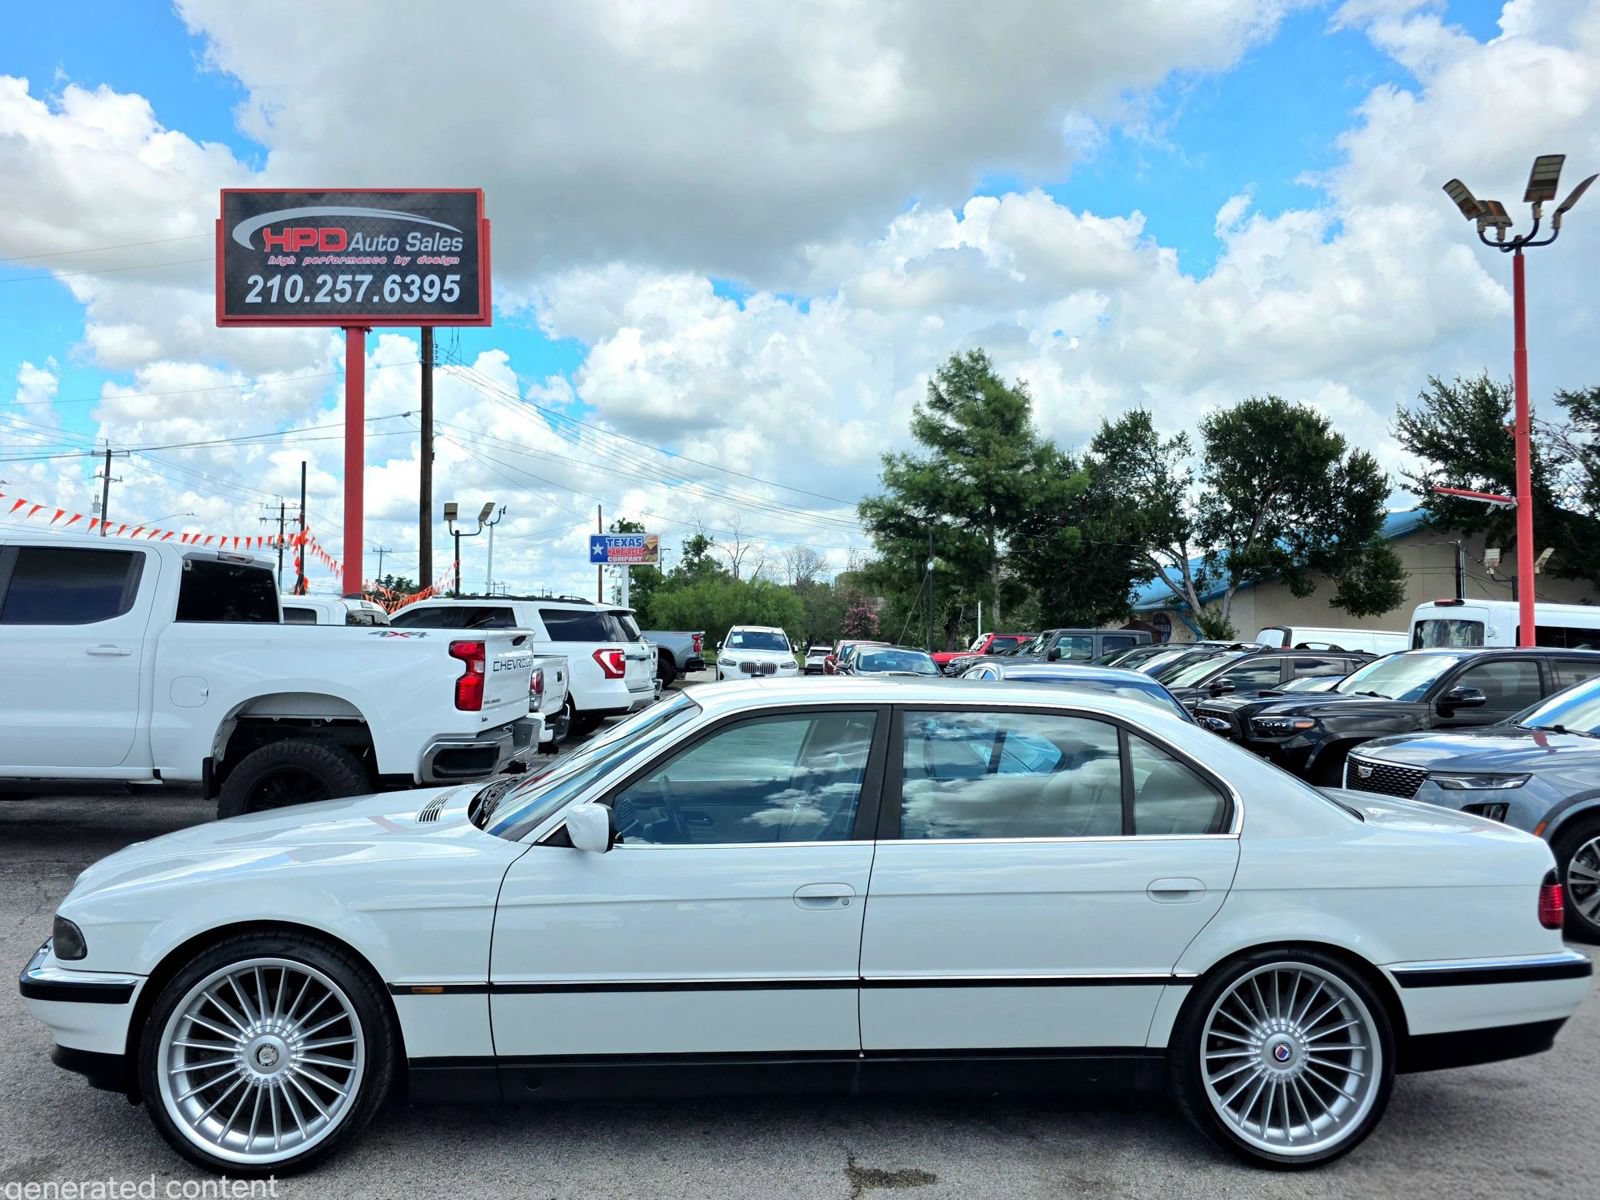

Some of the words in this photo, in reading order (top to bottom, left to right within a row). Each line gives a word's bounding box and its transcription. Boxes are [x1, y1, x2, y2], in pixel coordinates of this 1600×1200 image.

[262, 227, 347, 252] HPD
[348, 232, 399, 251] Auto
[406, 231, 463, 252] Sales
[268, 255, 297, 267] high
[302, 255, 387, 266] performance
[394, 255, 409, 265] by
[417, 255, 460, 266] design
[245, 274, 461, 304] 210.257.6395
[606, 538, 642, 547] TEXAS
